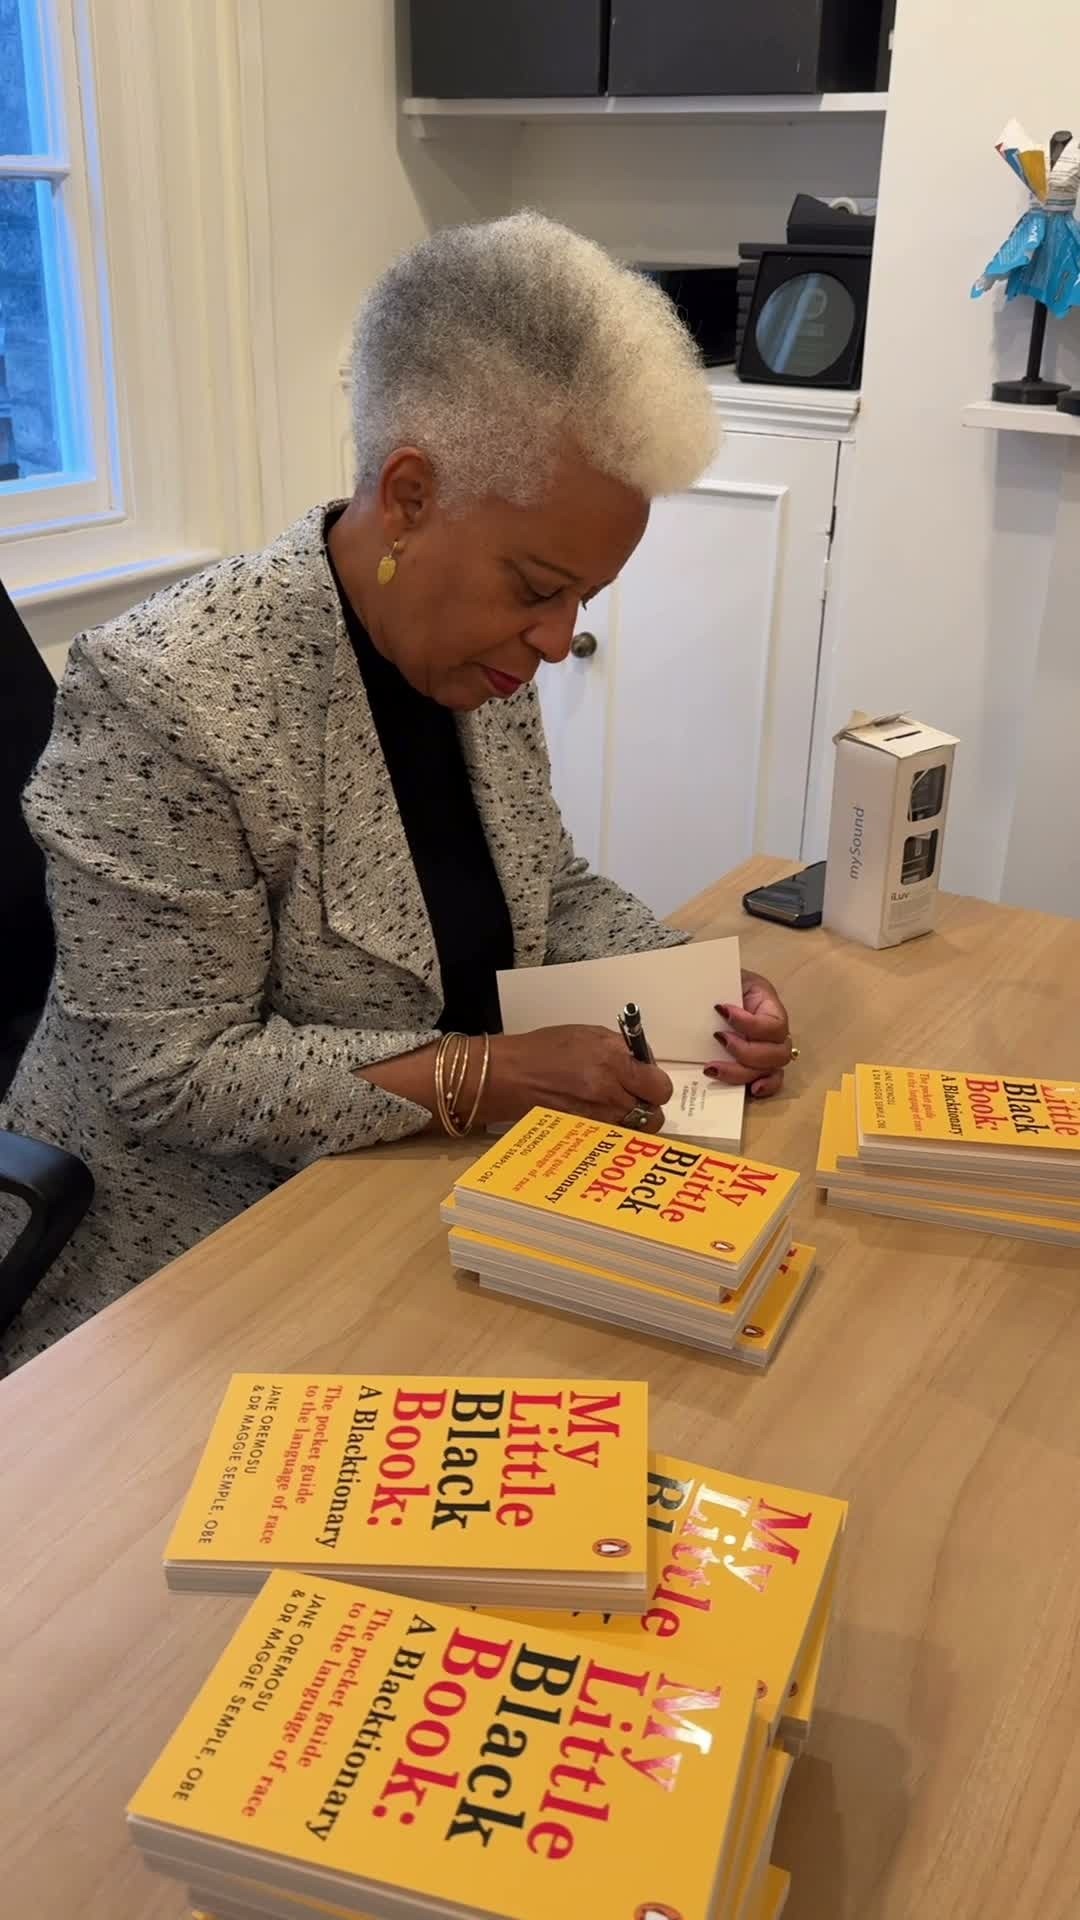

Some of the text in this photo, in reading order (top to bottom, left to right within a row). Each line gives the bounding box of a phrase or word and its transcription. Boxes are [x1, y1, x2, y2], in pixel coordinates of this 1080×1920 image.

[849, 806, 865, 880] mySound
[940, 1074, 963, 1136] A Blacktionary
[965, 1078, 1009, 1130] Book:
[1003, 1080, 1050, 1134] Black
[544, 1129, 623, 1204] A Blacktionary
[580, 1136, 664, 1203] Book:
[617, 1146, 701, 1214] Black
[659, 1156, 739, 1223] Little
[716, 1165, 778, 1207] My
[228, 1415, 253, 1461] MAGGIE
[244, 1385, 283, 1474] JANE OREMOSU
[246, 1395, 260, 1411] DR
[295, 1385, 343, 1504] The pocket guide
[366, 1388, 447, 1526] Book:
[431, 1389, 505, 1530] Black
[495, 1391, 563, 1527] Little
[553, 1391, 621, 1468] My
[259, 1385, 320, 1544] to the language of race
[315, 1385, 383, 1549] A Blacktionary
[198, 1519, 218, 1544] OBE
[640, 1483, 752, 1637] Little
[723, 1498, 812, 1592] My
[172, 1589, 305, 1802] & DR MAGGIE SEMPLE, OBE
[241, 1602, 366, 1817] to the language of race
[252, 1593, 326, 1712] JANE OREMOSU
[299, 1607, 393, 1768] The pocket guide
[305, 1614, 437, 1841] A Blacktionary
[372, 1627, 513, 1826] Book:
[444, 1642, 581, 1848] Black
[527, 1659, 650, 1860] Little
[621, 1673, 721, 1792] My
